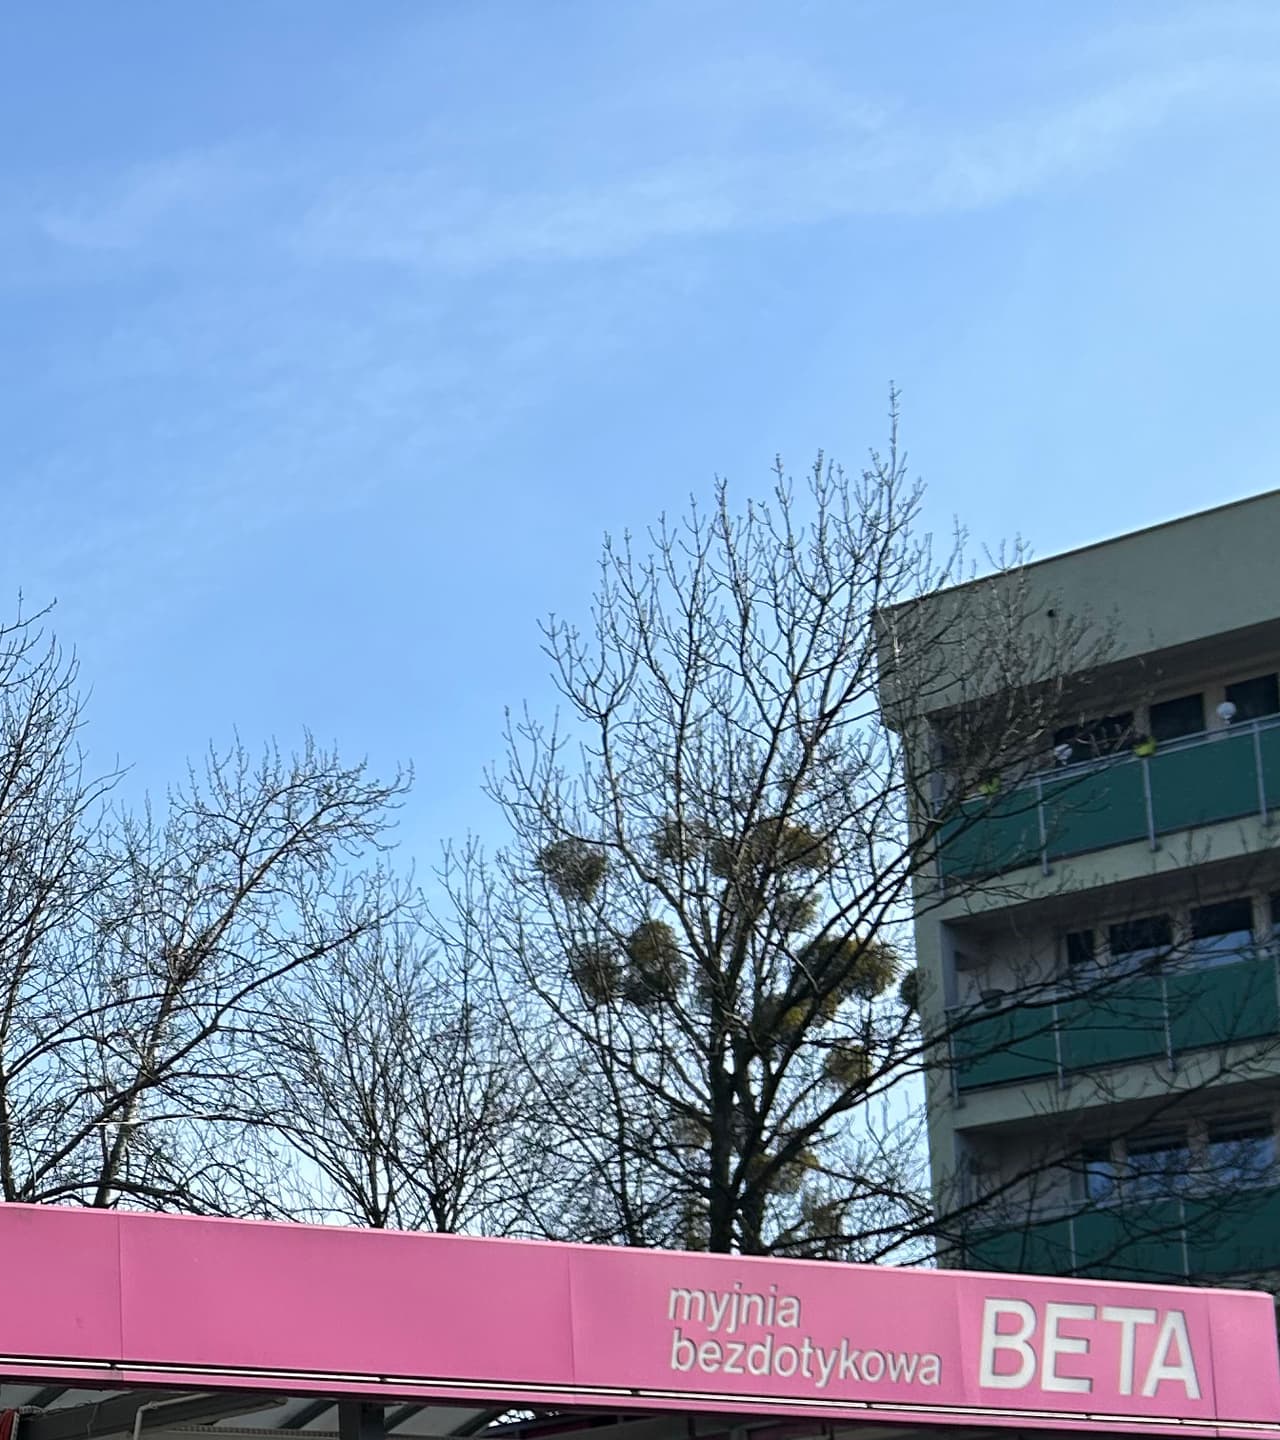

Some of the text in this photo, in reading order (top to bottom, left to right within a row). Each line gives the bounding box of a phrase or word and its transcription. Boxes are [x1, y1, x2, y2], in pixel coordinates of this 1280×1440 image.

[669, 1282, 801, 1333] myjnia
[670, 1328, 941, 1388] bezdotykowa
[978, 1297, 1202, 1400] BETA
